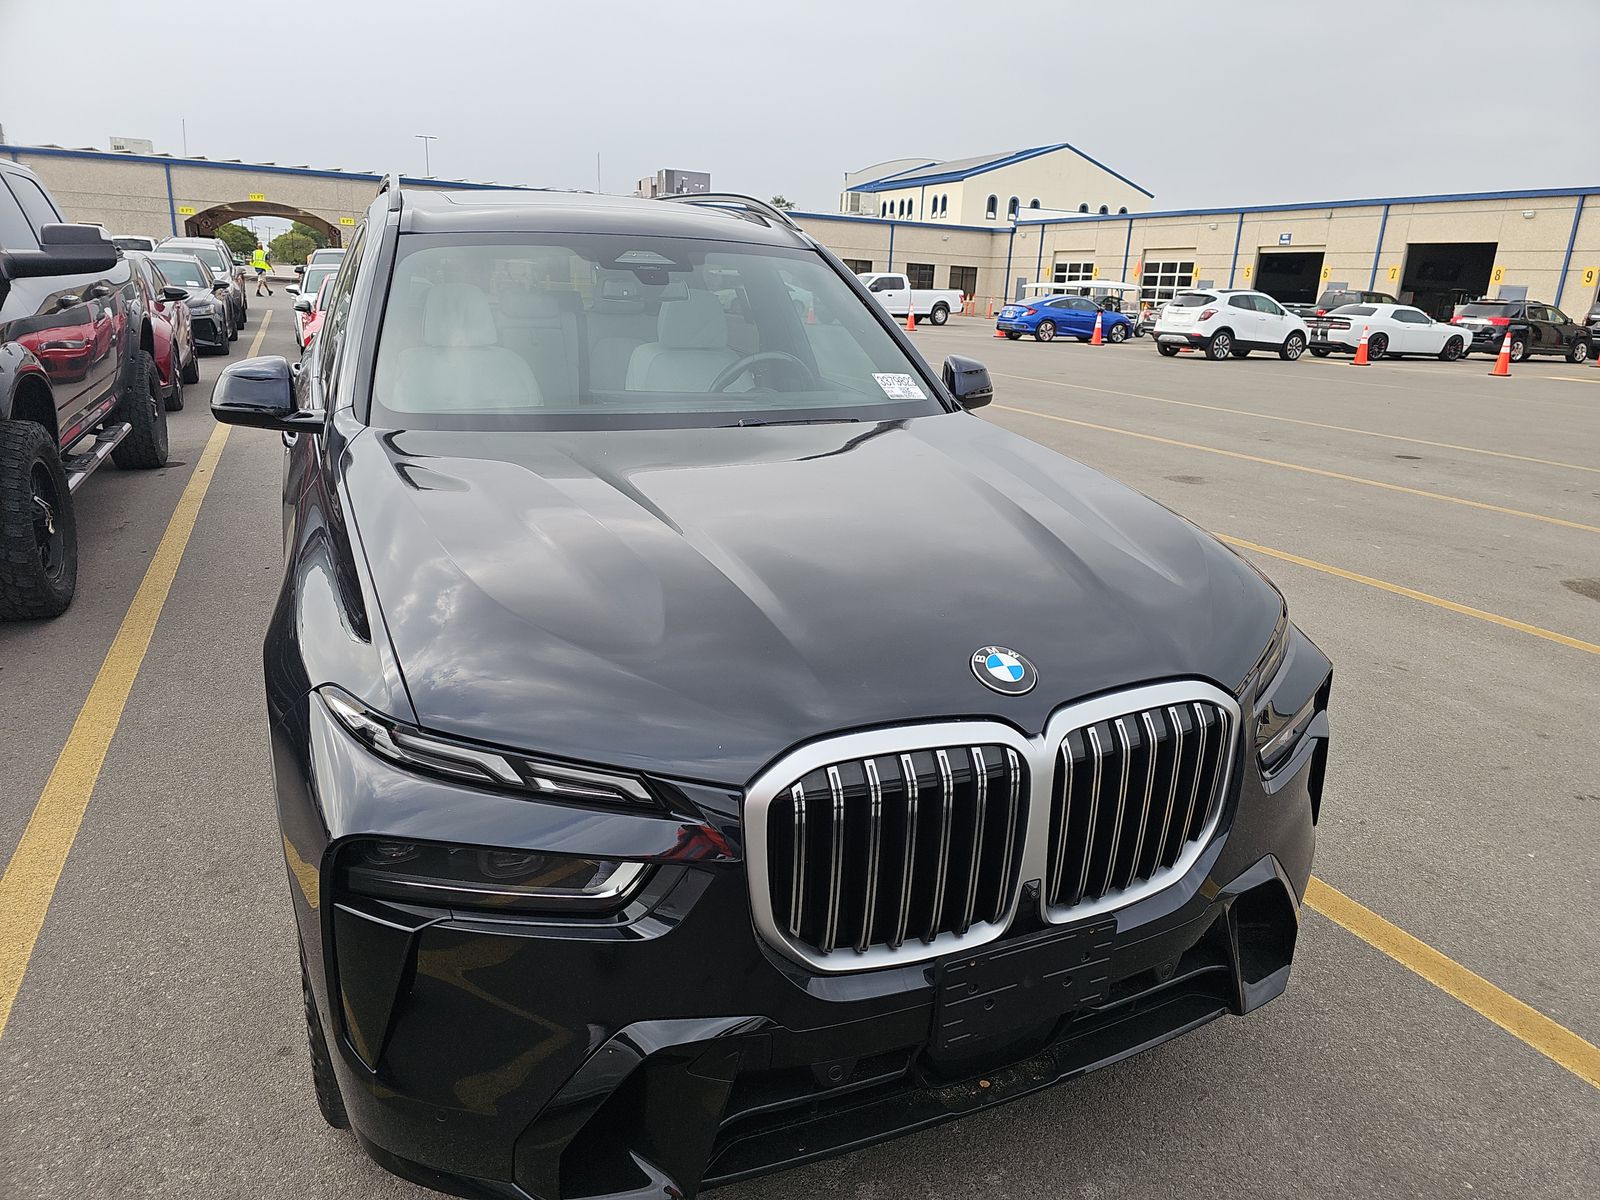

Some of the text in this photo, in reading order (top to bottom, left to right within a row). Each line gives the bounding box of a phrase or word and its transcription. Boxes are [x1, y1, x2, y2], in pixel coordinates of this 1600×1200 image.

[1391, 268, 1397, 279] 7
[1494, 269, 1501, 281] 8
[1585, 270, 1593, 283] 9
[974, 647, 1020, 663] BMW
